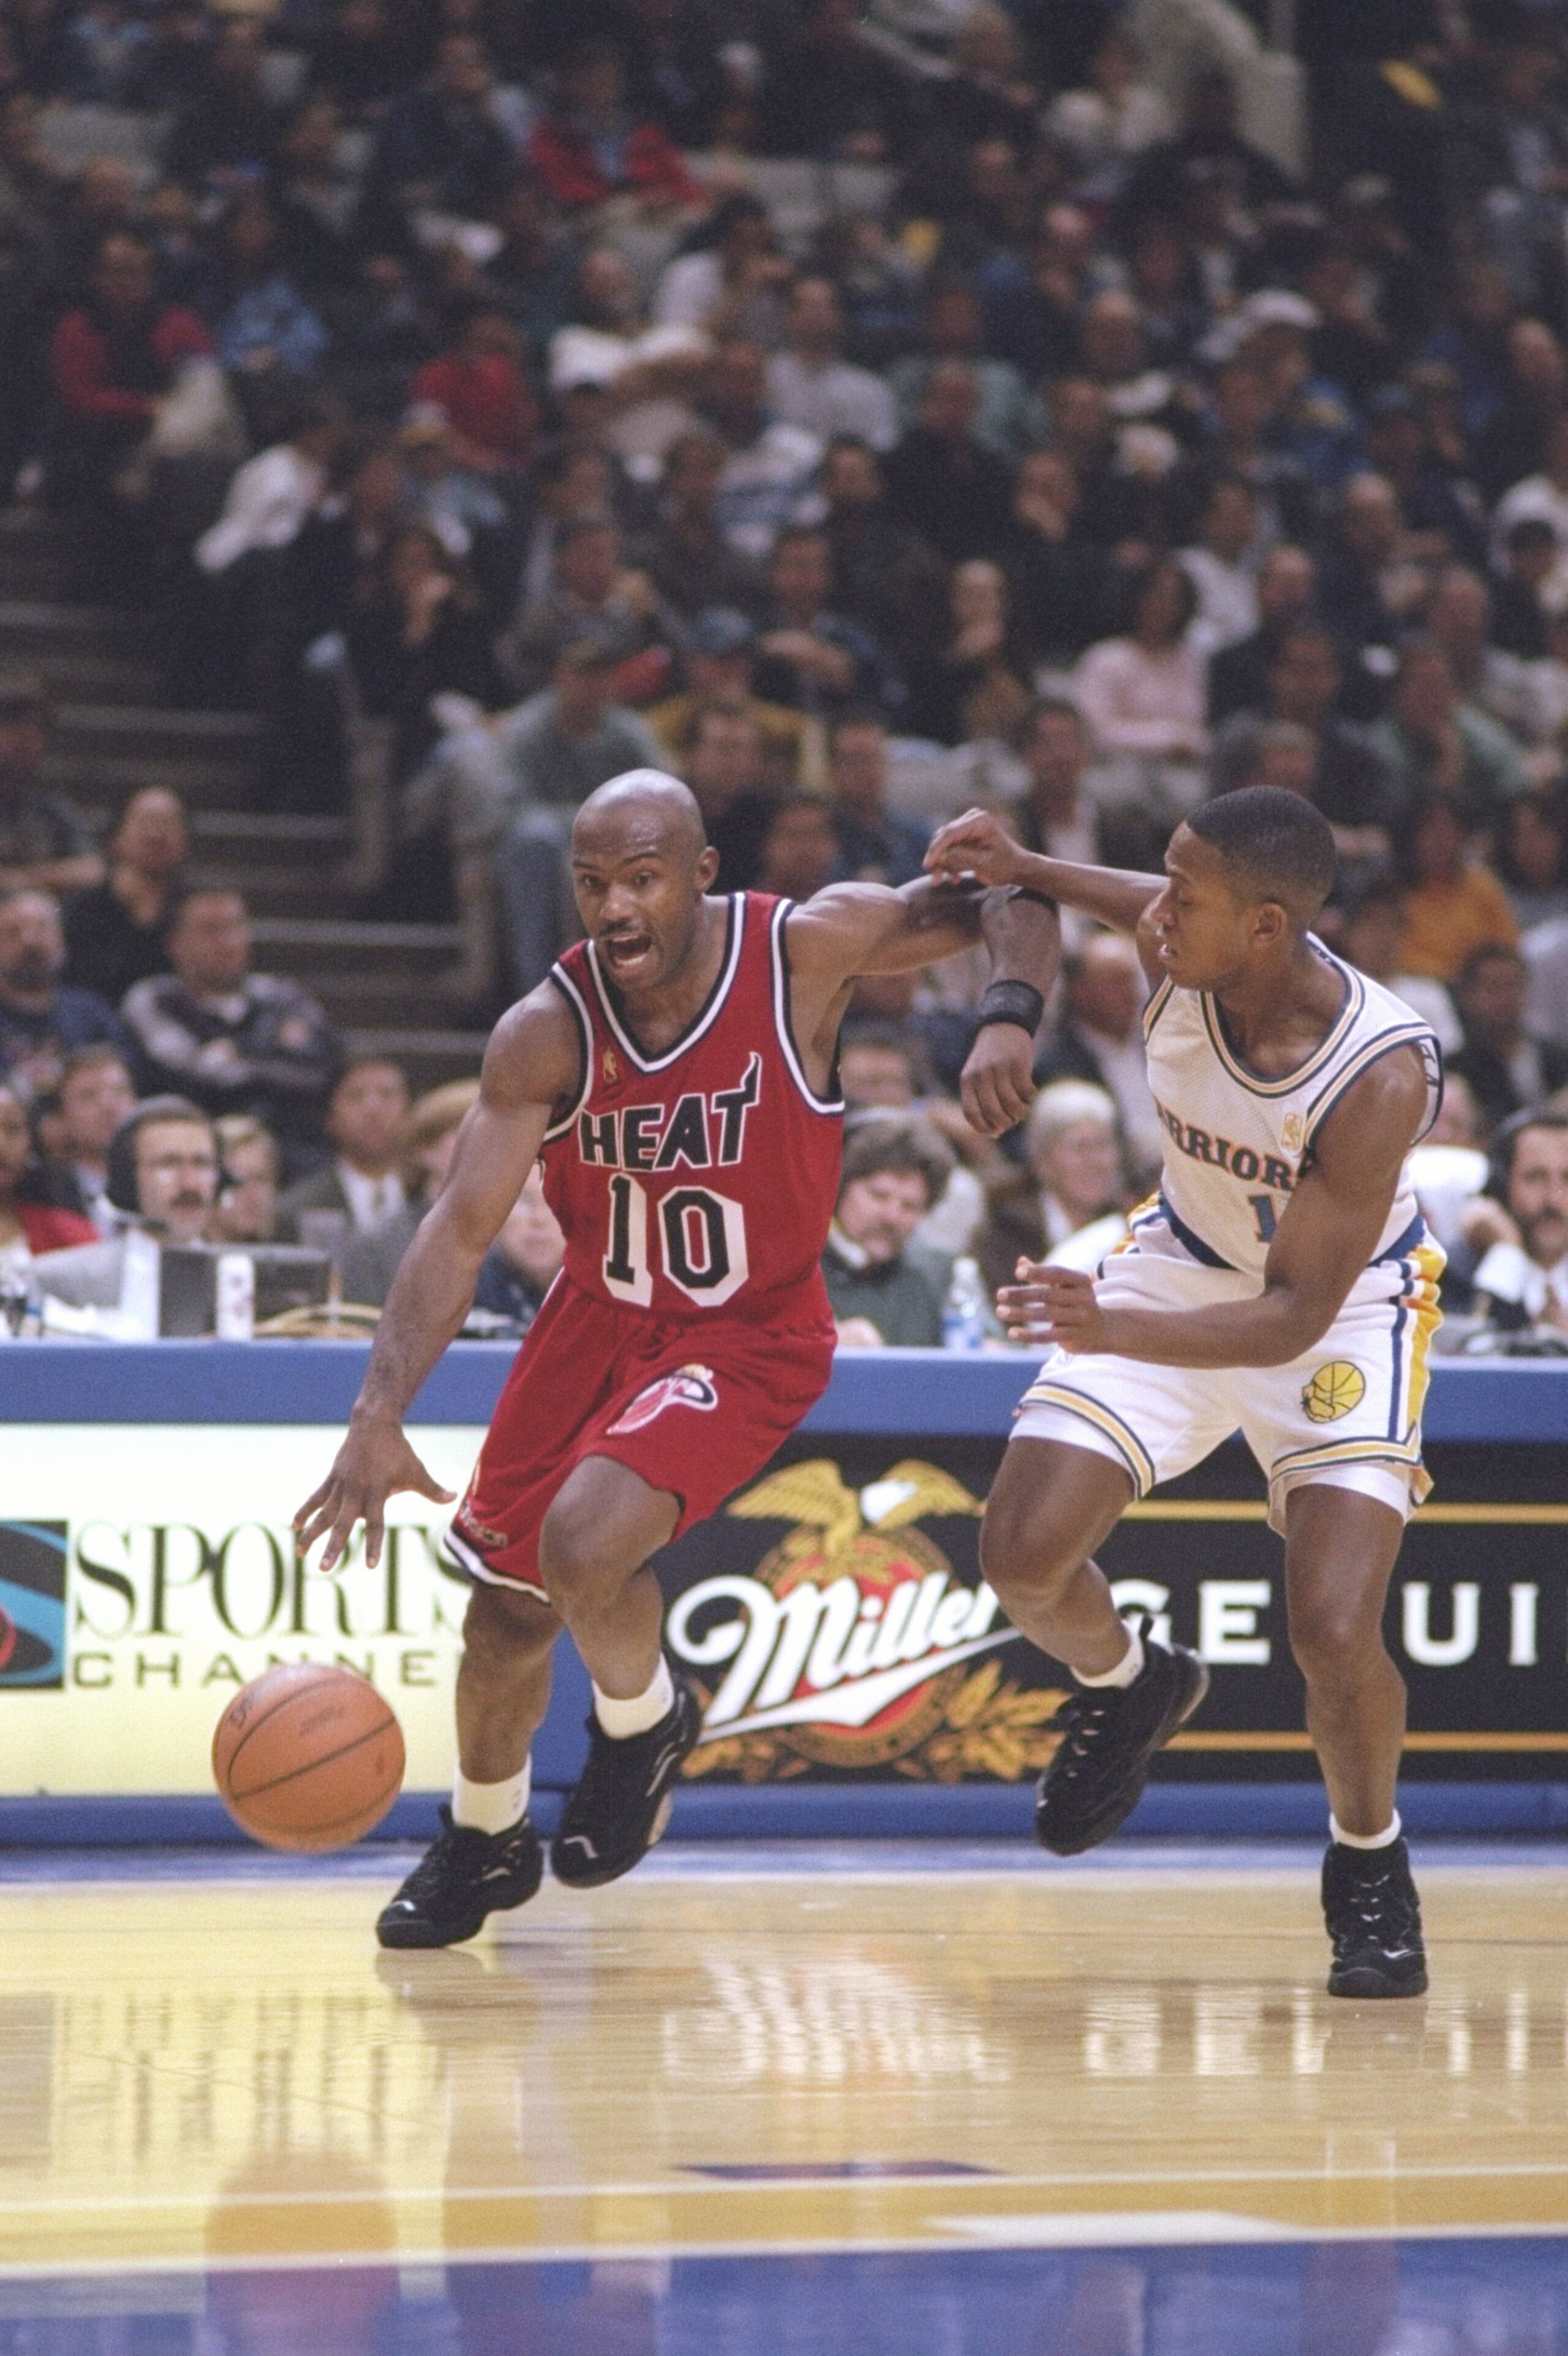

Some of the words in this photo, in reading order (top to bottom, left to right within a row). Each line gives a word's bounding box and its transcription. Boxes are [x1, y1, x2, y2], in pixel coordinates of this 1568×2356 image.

[578, 1052, 761, 1172] HEAT
[603, 1172, 749, 1308] 10
[666, 1570, 1000, 1727] Miller
